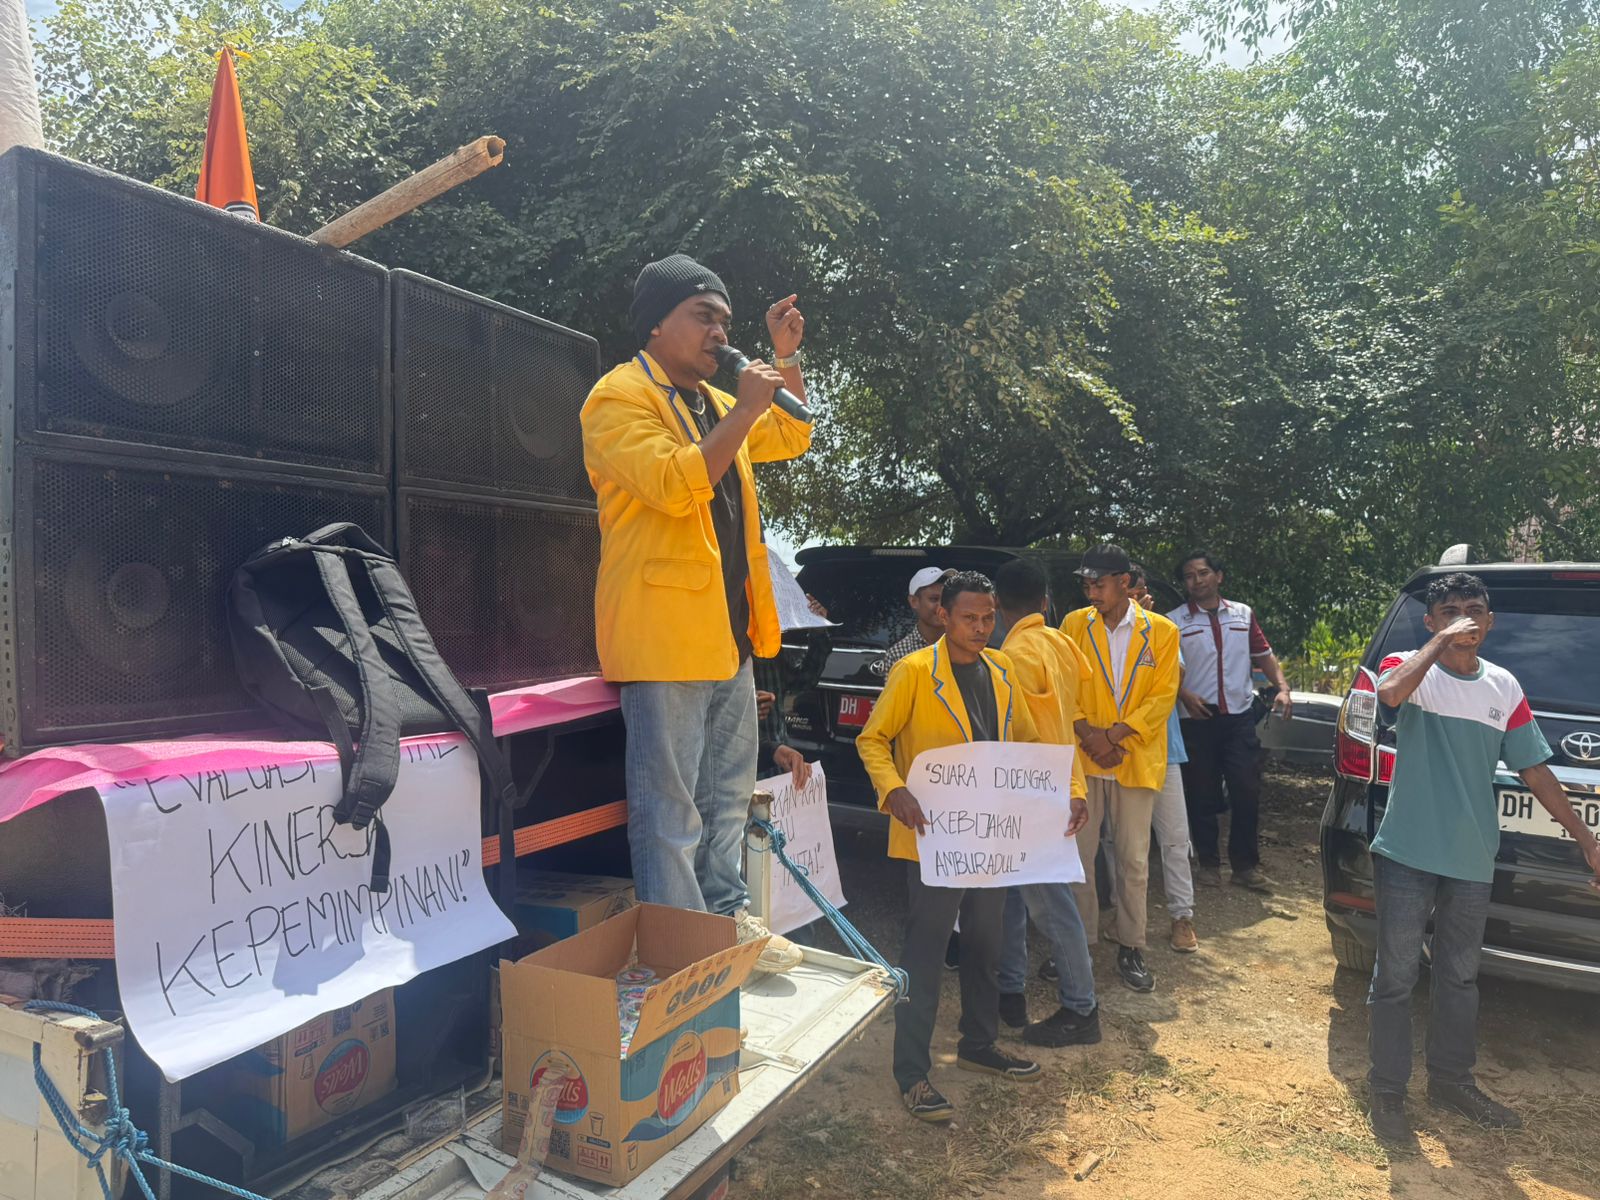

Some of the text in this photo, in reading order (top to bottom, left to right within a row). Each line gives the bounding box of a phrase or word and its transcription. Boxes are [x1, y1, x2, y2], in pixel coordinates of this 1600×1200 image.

[840, 697, 857, 715] DH
[1502, 794, 1533, 820] DH
[929, 809, 1022, 840] KEBIJAKAN
[663, 1056, 702, 1113] Wells
